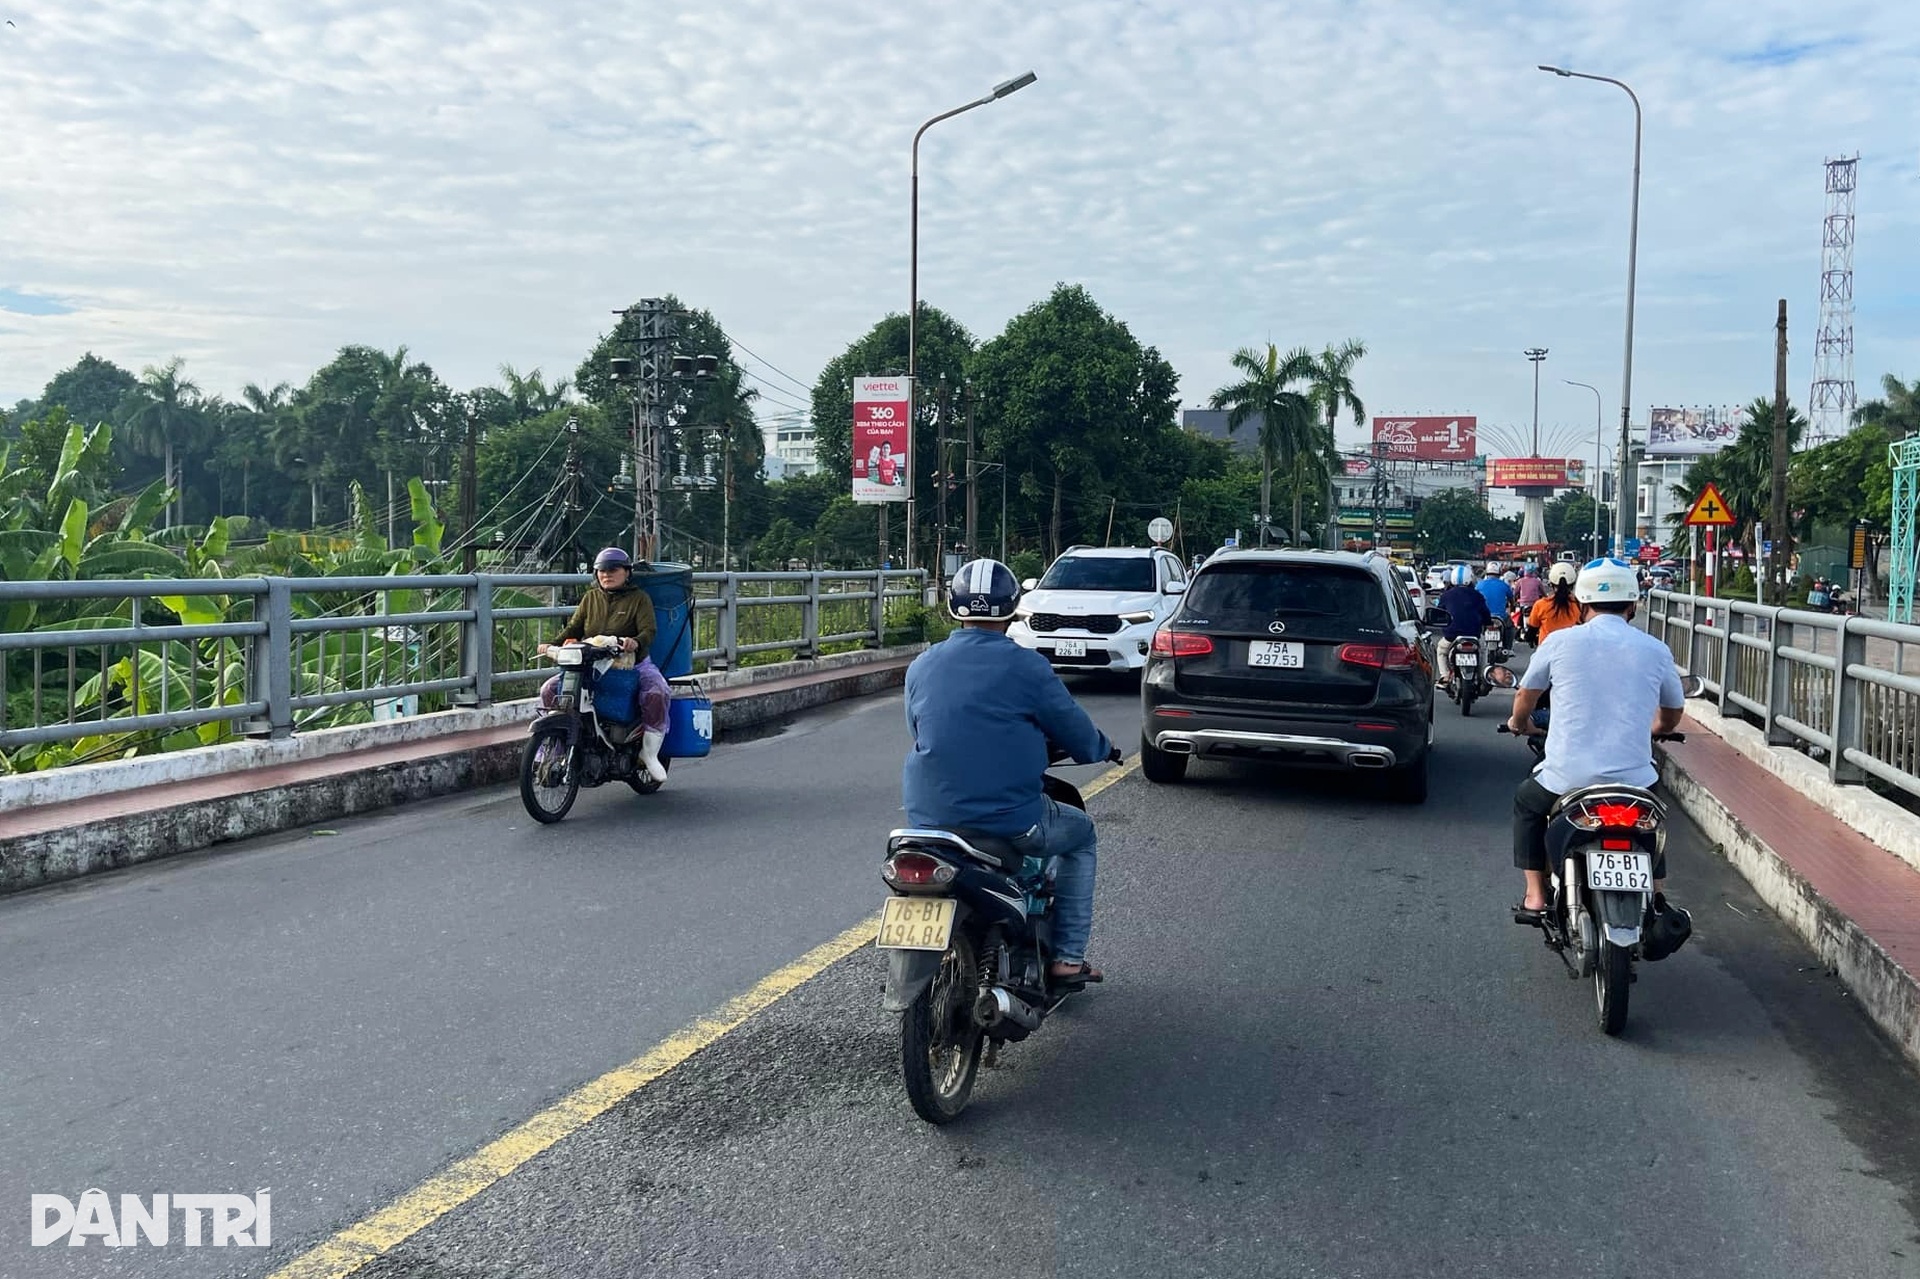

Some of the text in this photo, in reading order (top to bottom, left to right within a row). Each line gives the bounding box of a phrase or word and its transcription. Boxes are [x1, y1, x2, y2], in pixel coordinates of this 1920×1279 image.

[863, 382, 899, 391] viettel
[1265, 642, 1288, 653] 75A
[1255, 653, 1298, 666] 297.53
[1596, 853, 1639, 870] 76-B1
[1592, 871, 1649, 889] 658.62
[895, 901, 943, 921] 76-B1
[884, 924, 944, 946] 194.84
